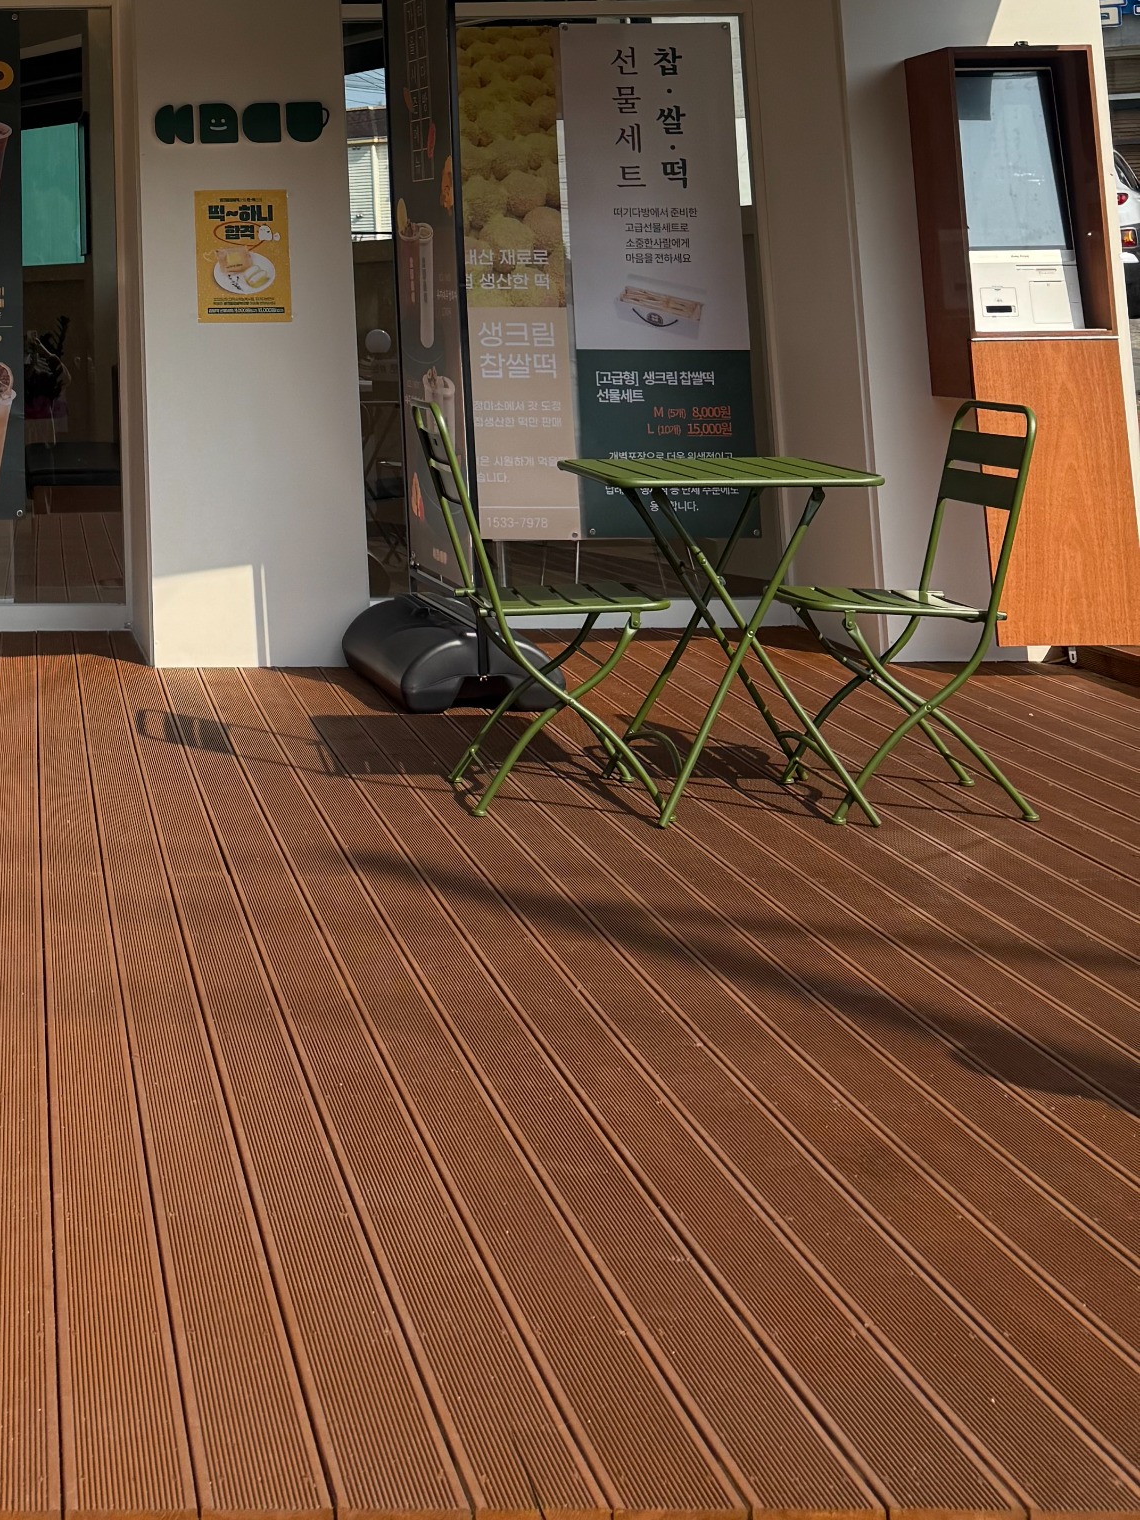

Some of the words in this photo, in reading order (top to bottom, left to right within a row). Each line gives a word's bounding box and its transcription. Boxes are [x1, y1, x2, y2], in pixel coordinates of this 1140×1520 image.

[611, 46, 646, 188] 선물세트
[613, 207, 668, 218] 떠기다방에서
[670, 207, 697, 218] 준비한
[625, 222, 689, 233] 고급선물세트로
[499, 249, 549, 265] 재료로
[625, 253, 653, 263] 마음을
[654, 253, 691, 263] 전하세요
[480, 273, 529, 290] 생산한
[534, 273, 550, 290] 떡
[478, 321, 555, 347] 생크림
[480, 352, 557, 379] 찹쌀떡
[596, 371, 639, 386] [고급형]
[643, 371, 678, 385] 생크림
[680, 371, 715, 386] 찹쌀떡
[597, 389, 645, 403] 선물세트
[653, 407, 663, 417] M
[668, 409, 686, 419] (5개)
[692, 406, 731, 419] 8,000원
[647, 424, 654, 434] L
[657, 425, 681, 436] (10개)
[687, 423, 732, 436] 15,000원
[487, 517, 549, 528] 1533-7978
